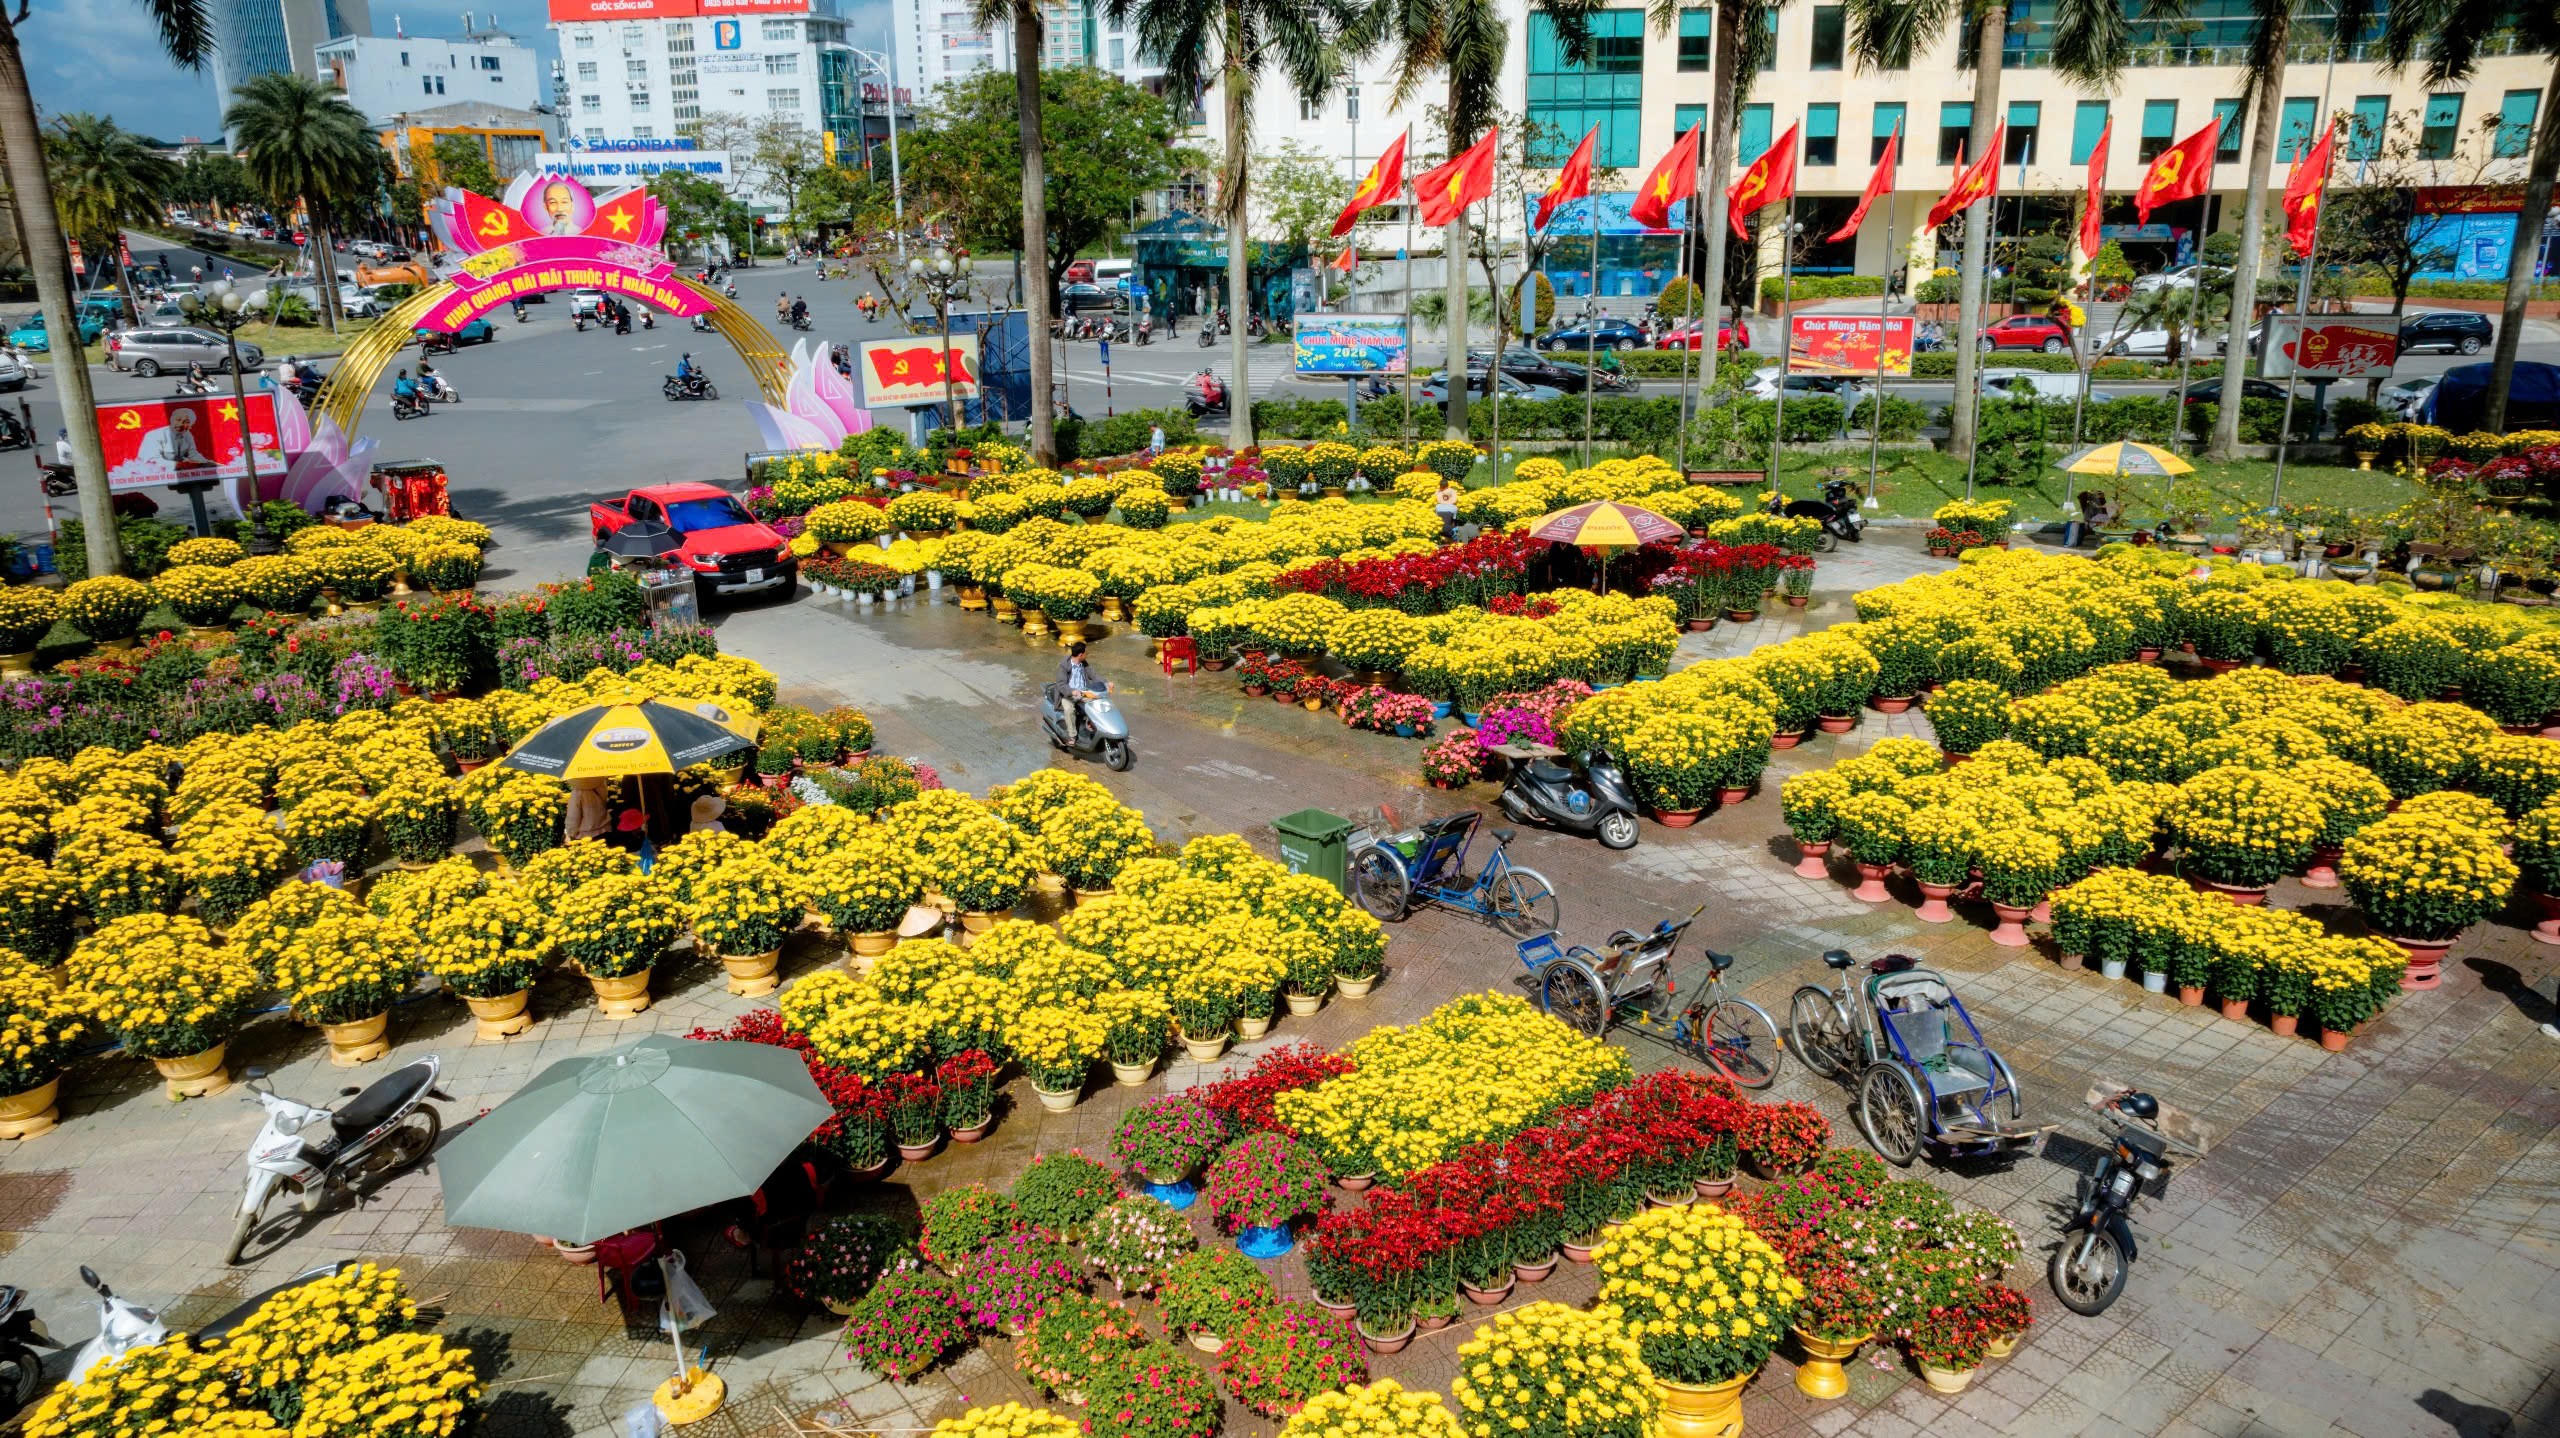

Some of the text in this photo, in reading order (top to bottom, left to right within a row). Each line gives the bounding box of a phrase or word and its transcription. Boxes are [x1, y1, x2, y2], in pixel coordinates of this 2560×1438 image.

[589, 138, 695, 152] SAIGONBANK
[597, 163, 622, 177] TMCP
[443, 300, 474, 329] VINH
[471, 281, 512, 310] QUANG
[512, 272, 537, 292] MÃI
[538, 268, 563, 287] MÃI
[565, 268, 603, 288] THUỘC
[622, 275, 656, 298] NHÂN
[655, 288, 681, 311] DÂN
[1803, 320, 1826, 331] Chúc
[1828, 320, 1856, 332] Mừng
